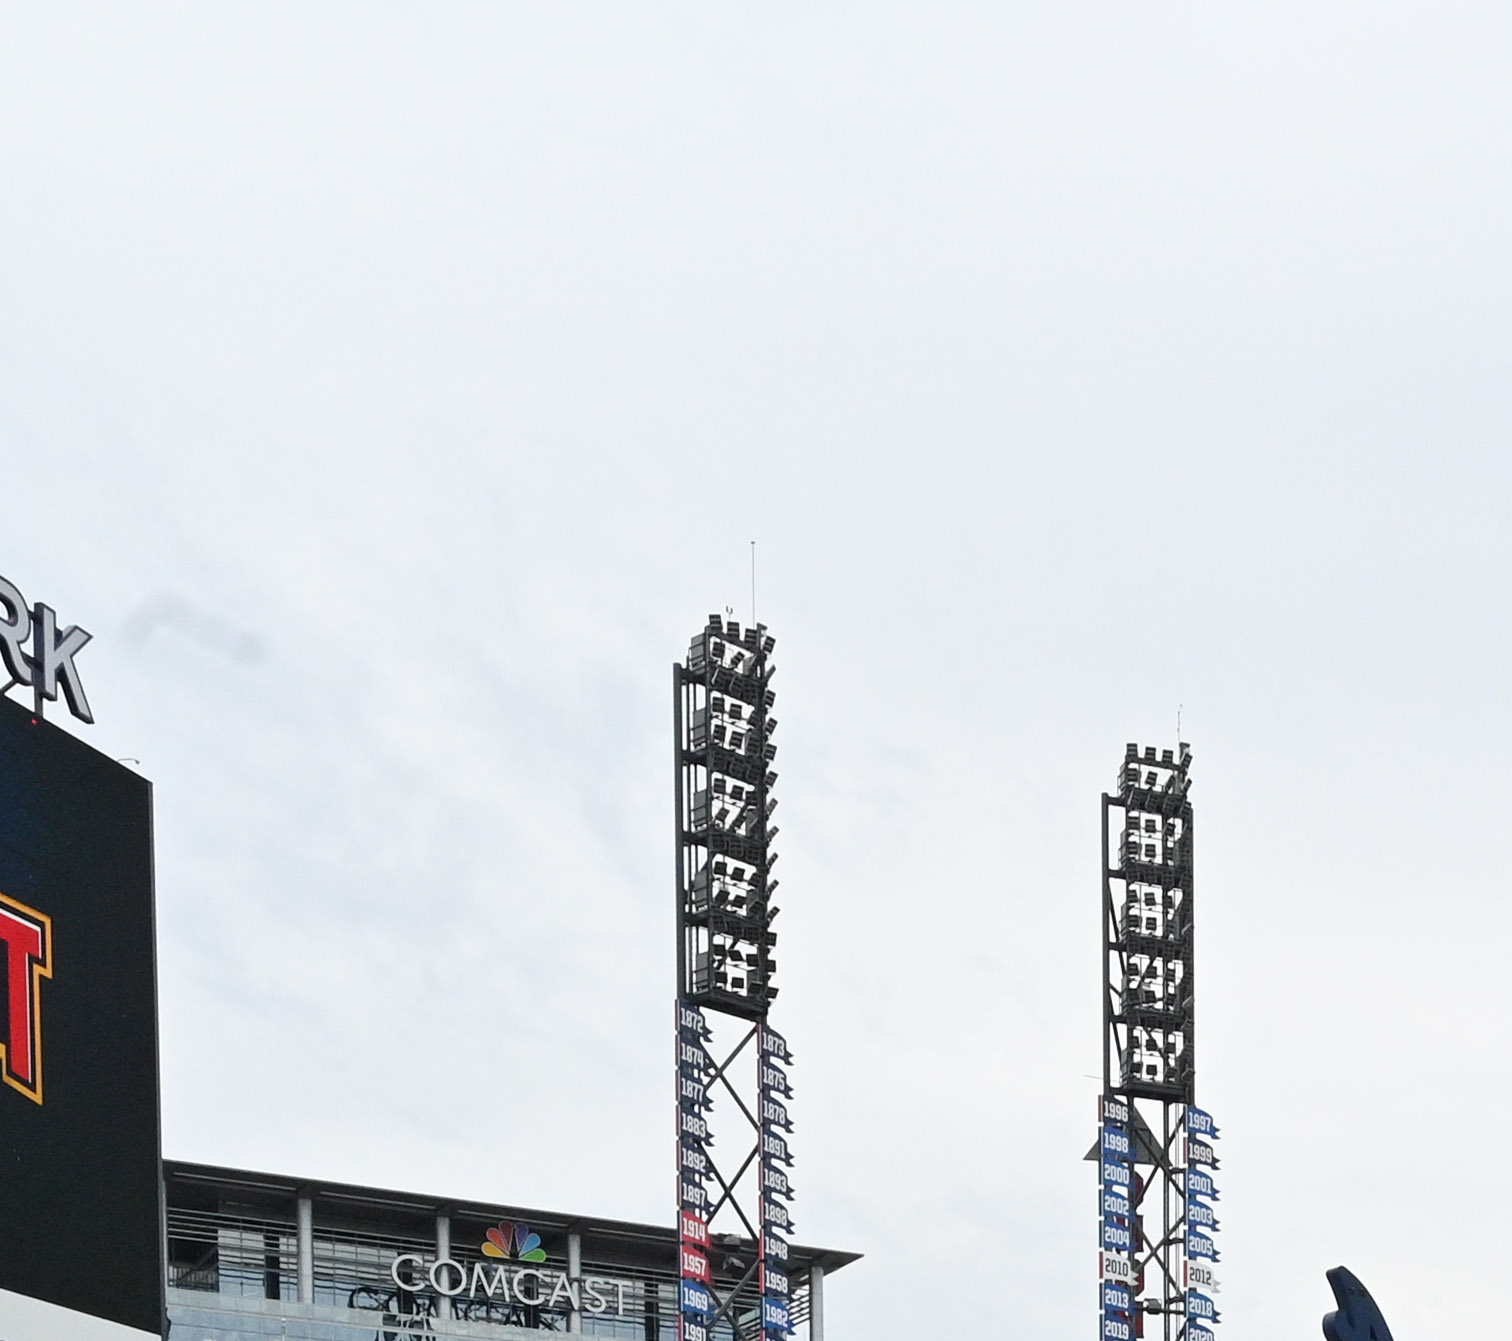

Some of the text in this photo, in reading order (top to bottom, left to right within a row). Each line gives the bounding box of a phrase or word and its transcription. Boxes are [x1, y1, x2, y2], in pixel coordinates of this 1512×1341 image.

[680, 1006, 704, 1034] 1872
[681, 1042, 705, 1068] 1874
[762, 1064, 786, 1091] 1875
[681, 1076, 705, 1104] 1877
[681, 1111, 706, 1137] 1883
[1104, 1103, 1129, 1123] 1996
[1188, 1111, 1212, 1132] 1997
[763, 1132, 786, 1159] 1891
[1104, 1134, 1129, 1153] 1998
[1188, 1142, 1213, 1163] 1999
[682, 1147, 706, 1172] 1892
[763, 1166, 787, 1193] 1893
[1104, 1165, 1130, 1185] 2000
[1188, 1174, 1213, 1195] 2001
[682, 1182, 706, 1207] 1897
[1104, 1196, 1130, 1216] 2002
[1188, 1204, 1213, 1225] 2003
[683, 1217, 706, 1243] 1914
[1104, 1226, 1130, 1247] 2004
[1188, 1235, 1214, 1256] 2005
[683, 1252, 706, 1278] 1957
[1105, 1257, 1129, 1276] 2010
[1188, 1266, 1213, 1286] 2012
[390, 1253, 631, 1316] COMCAST
[765, 1269, 788, 1294] 1958
[683, 1286, 708, 1312] 1969
[1105, 1289, 1129, 1309] 2013
[1188, 1297, 1213, 1317] 2018
[765, 1302, 789, 1328] 1982
[1105, 1320, 1129, 1340] 2019
